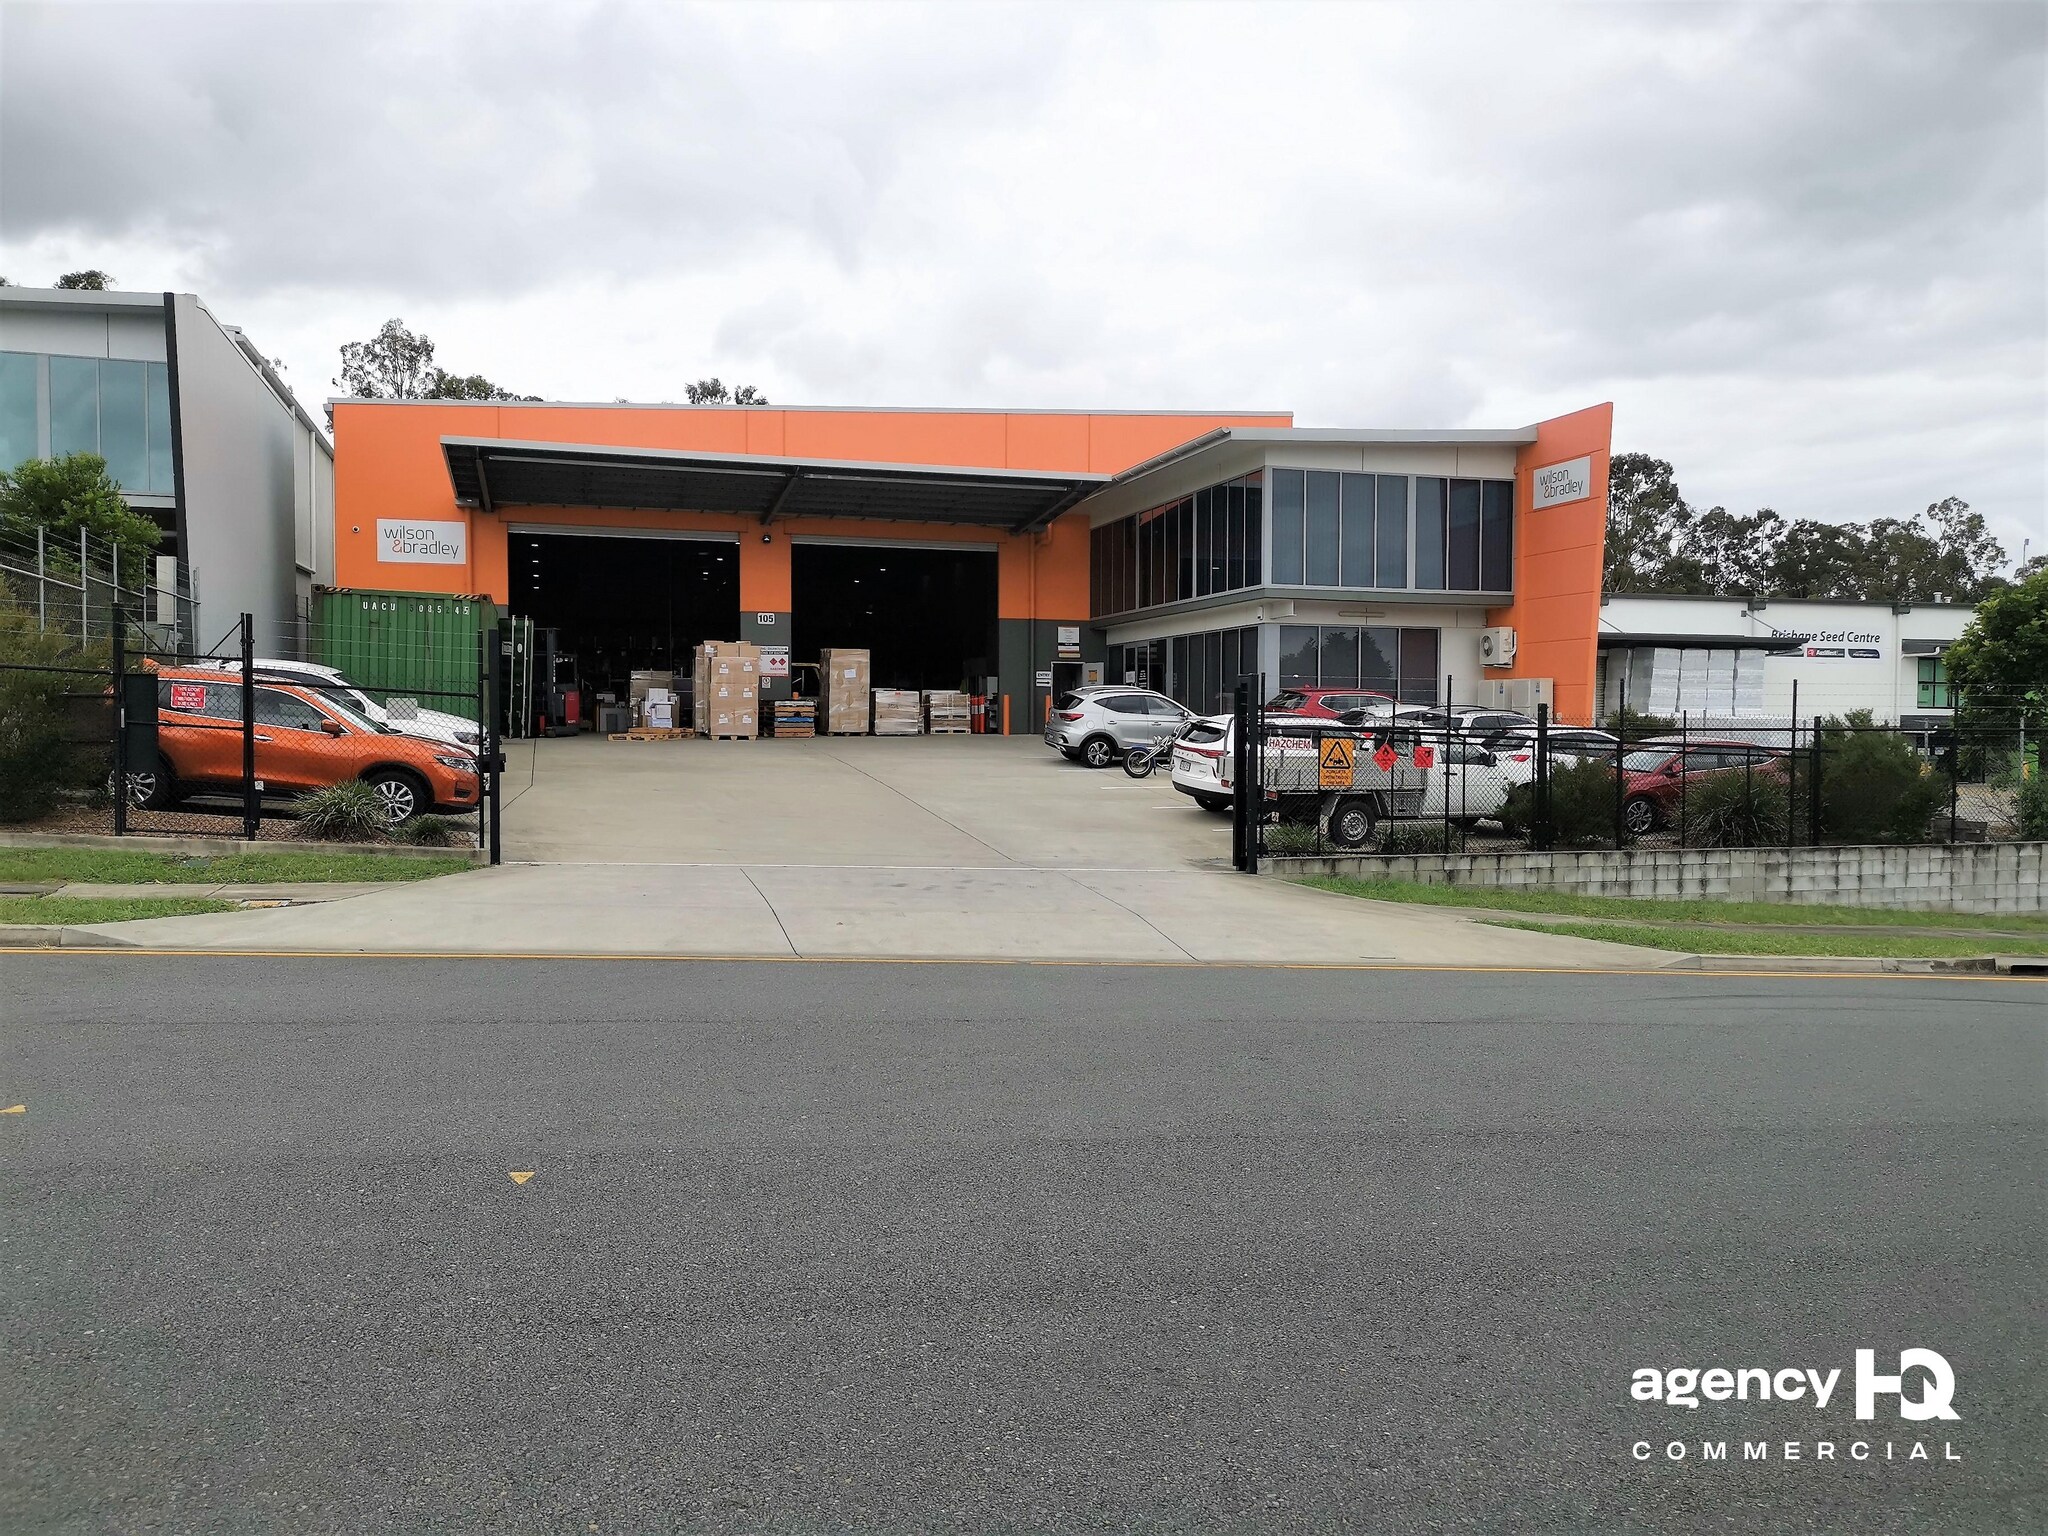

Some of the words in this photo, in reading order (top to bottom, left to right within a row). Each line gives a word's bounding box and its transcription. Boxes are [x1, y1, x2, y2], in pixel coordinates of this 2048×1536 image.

[1540, 469, 1569, 486] wilson
[1544, 479, 1583, 499] &bradley
[383, 525, 435, 541] wilson
[391, 539, 459, 559] &bradley
[362, 601, 396, 611] UACU
[758, 614, 774, 623] 105
[1820, 630, 1845, 642] Seed
[1847, 631, 1881, 643] Centre
[1269, 739, 1312, 750] HAZCHEM
